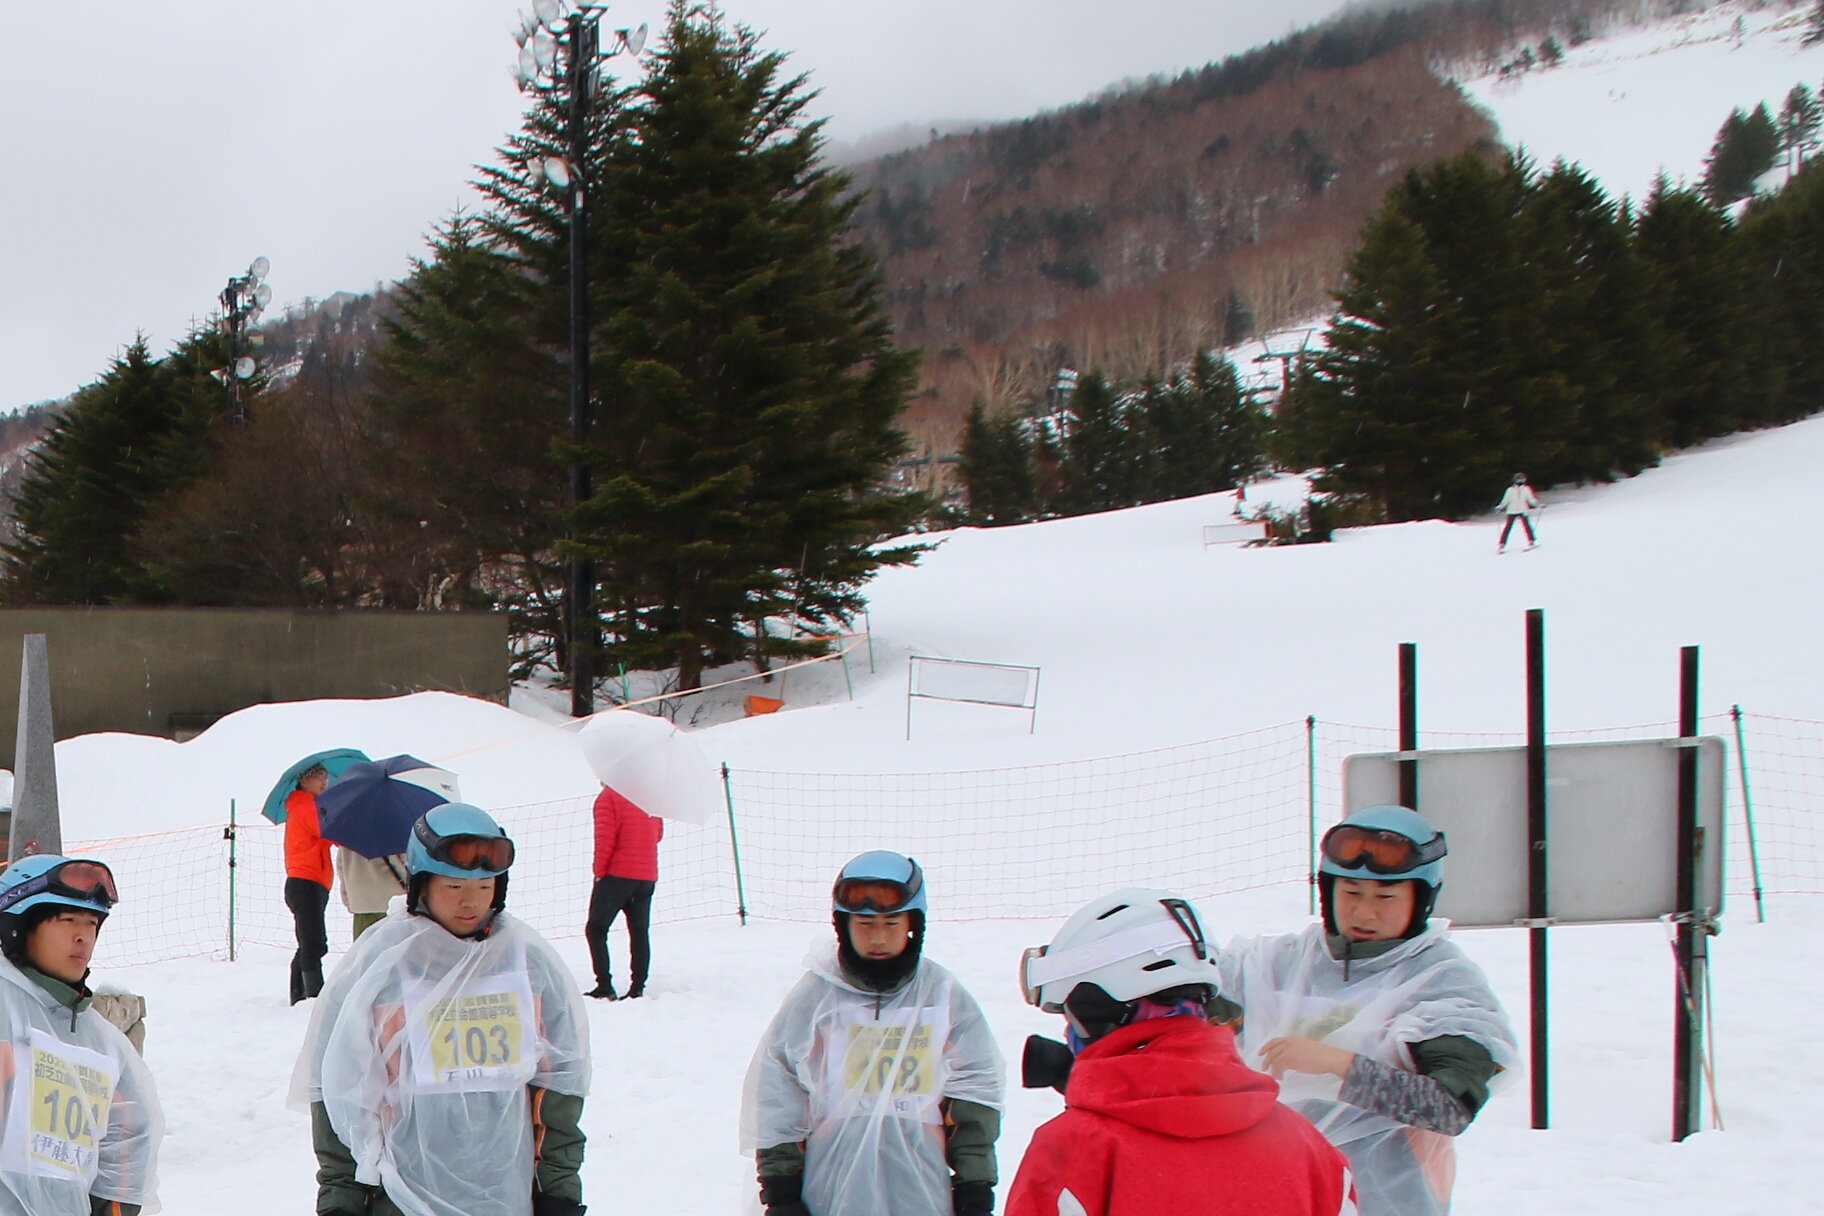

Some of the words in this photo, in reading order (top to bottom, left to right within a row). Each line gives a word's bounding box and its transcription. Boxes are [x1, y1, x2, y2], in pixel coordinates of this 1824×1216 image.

[444, 1025, 511, 1066] 103
[855, 1055, 921, 1093] 108
[44, 1089, 100, 1147] 104
